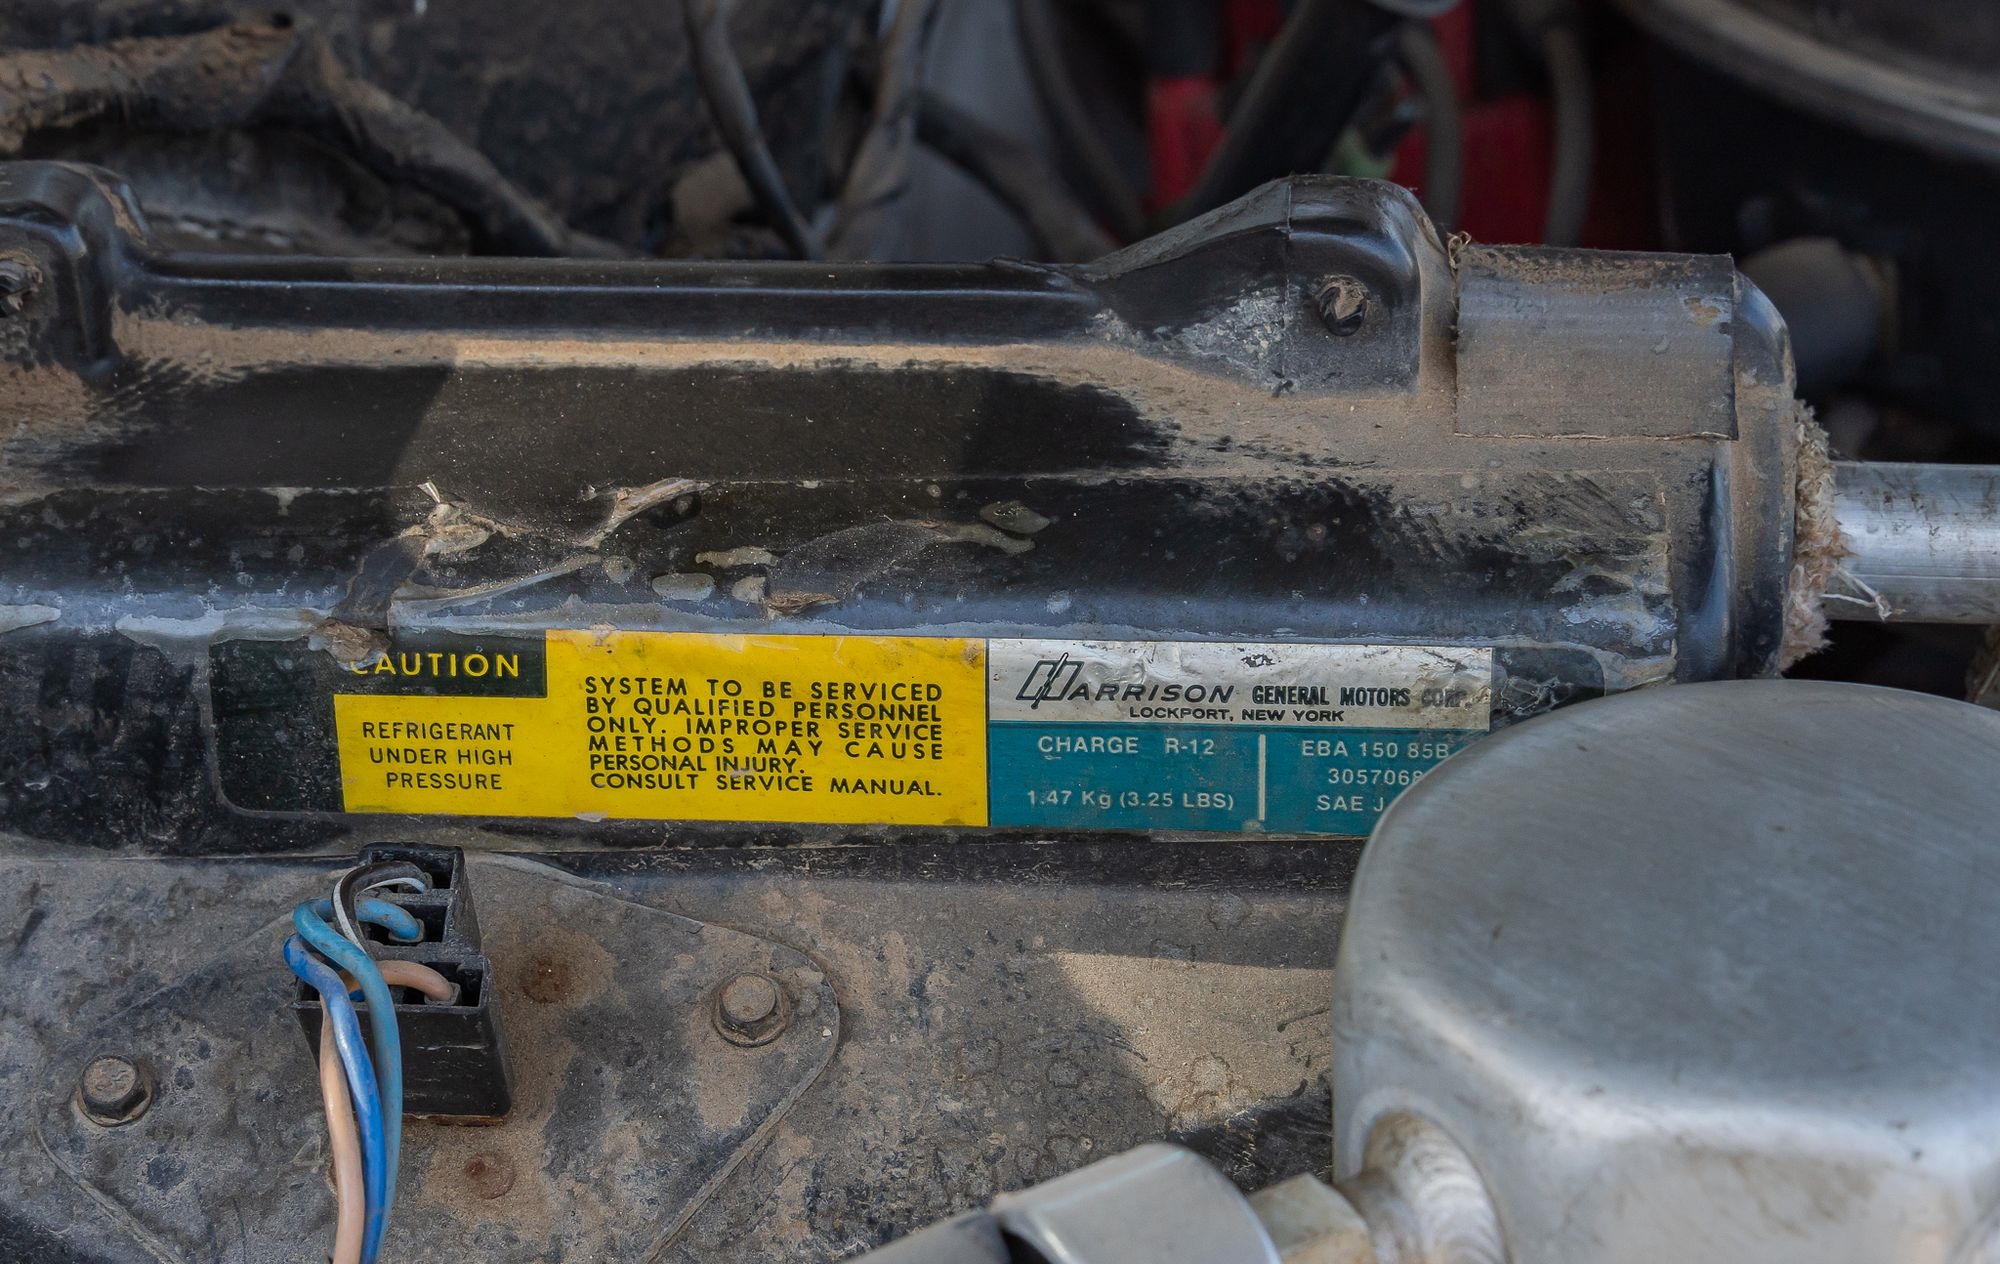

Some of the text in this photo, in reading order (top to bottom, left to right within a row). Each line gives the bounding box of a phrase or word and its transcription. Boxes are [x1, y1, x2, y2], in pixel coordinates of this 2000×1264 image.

[585, 676, 943, 702] SYSTEM TO BE SERVICED
[1252, 685, 1330, 706] GENERAL
[1339, 687, 1411, 707] MOTORS
[586, 697, 942, 722] BY QUALIFIED PERSONNEL
[1129, 706, 1345, 723] LOCKPORT, NEW YORK
[362, 721, 515, 741] REFRIGERANT
[586, 716, 942, 741] ONLY. IMPROPER SERVICE
[588, 736, 943, 760] METHODS MAY CAUSE
[1038, 736, 1215, 755] CHARGE R-12
[1301, 740, 1450, 759] EBA 150 85B
[369, 748, 513, 766] UNDER HIGH
[590, 755, 805, 774] PERSONAL INJURY.
[386, 772, 503, 791] PRESSURE
[590, 773, 942, 797] CONSULT SERVICE MANUAL.
[1081, 792, 1112, 809] Kg
[1119, 792, 1174, 808] (3.25
[1182, 793, 1235, 811] LBS)
[1316, 795, 1364, 812] SAE
